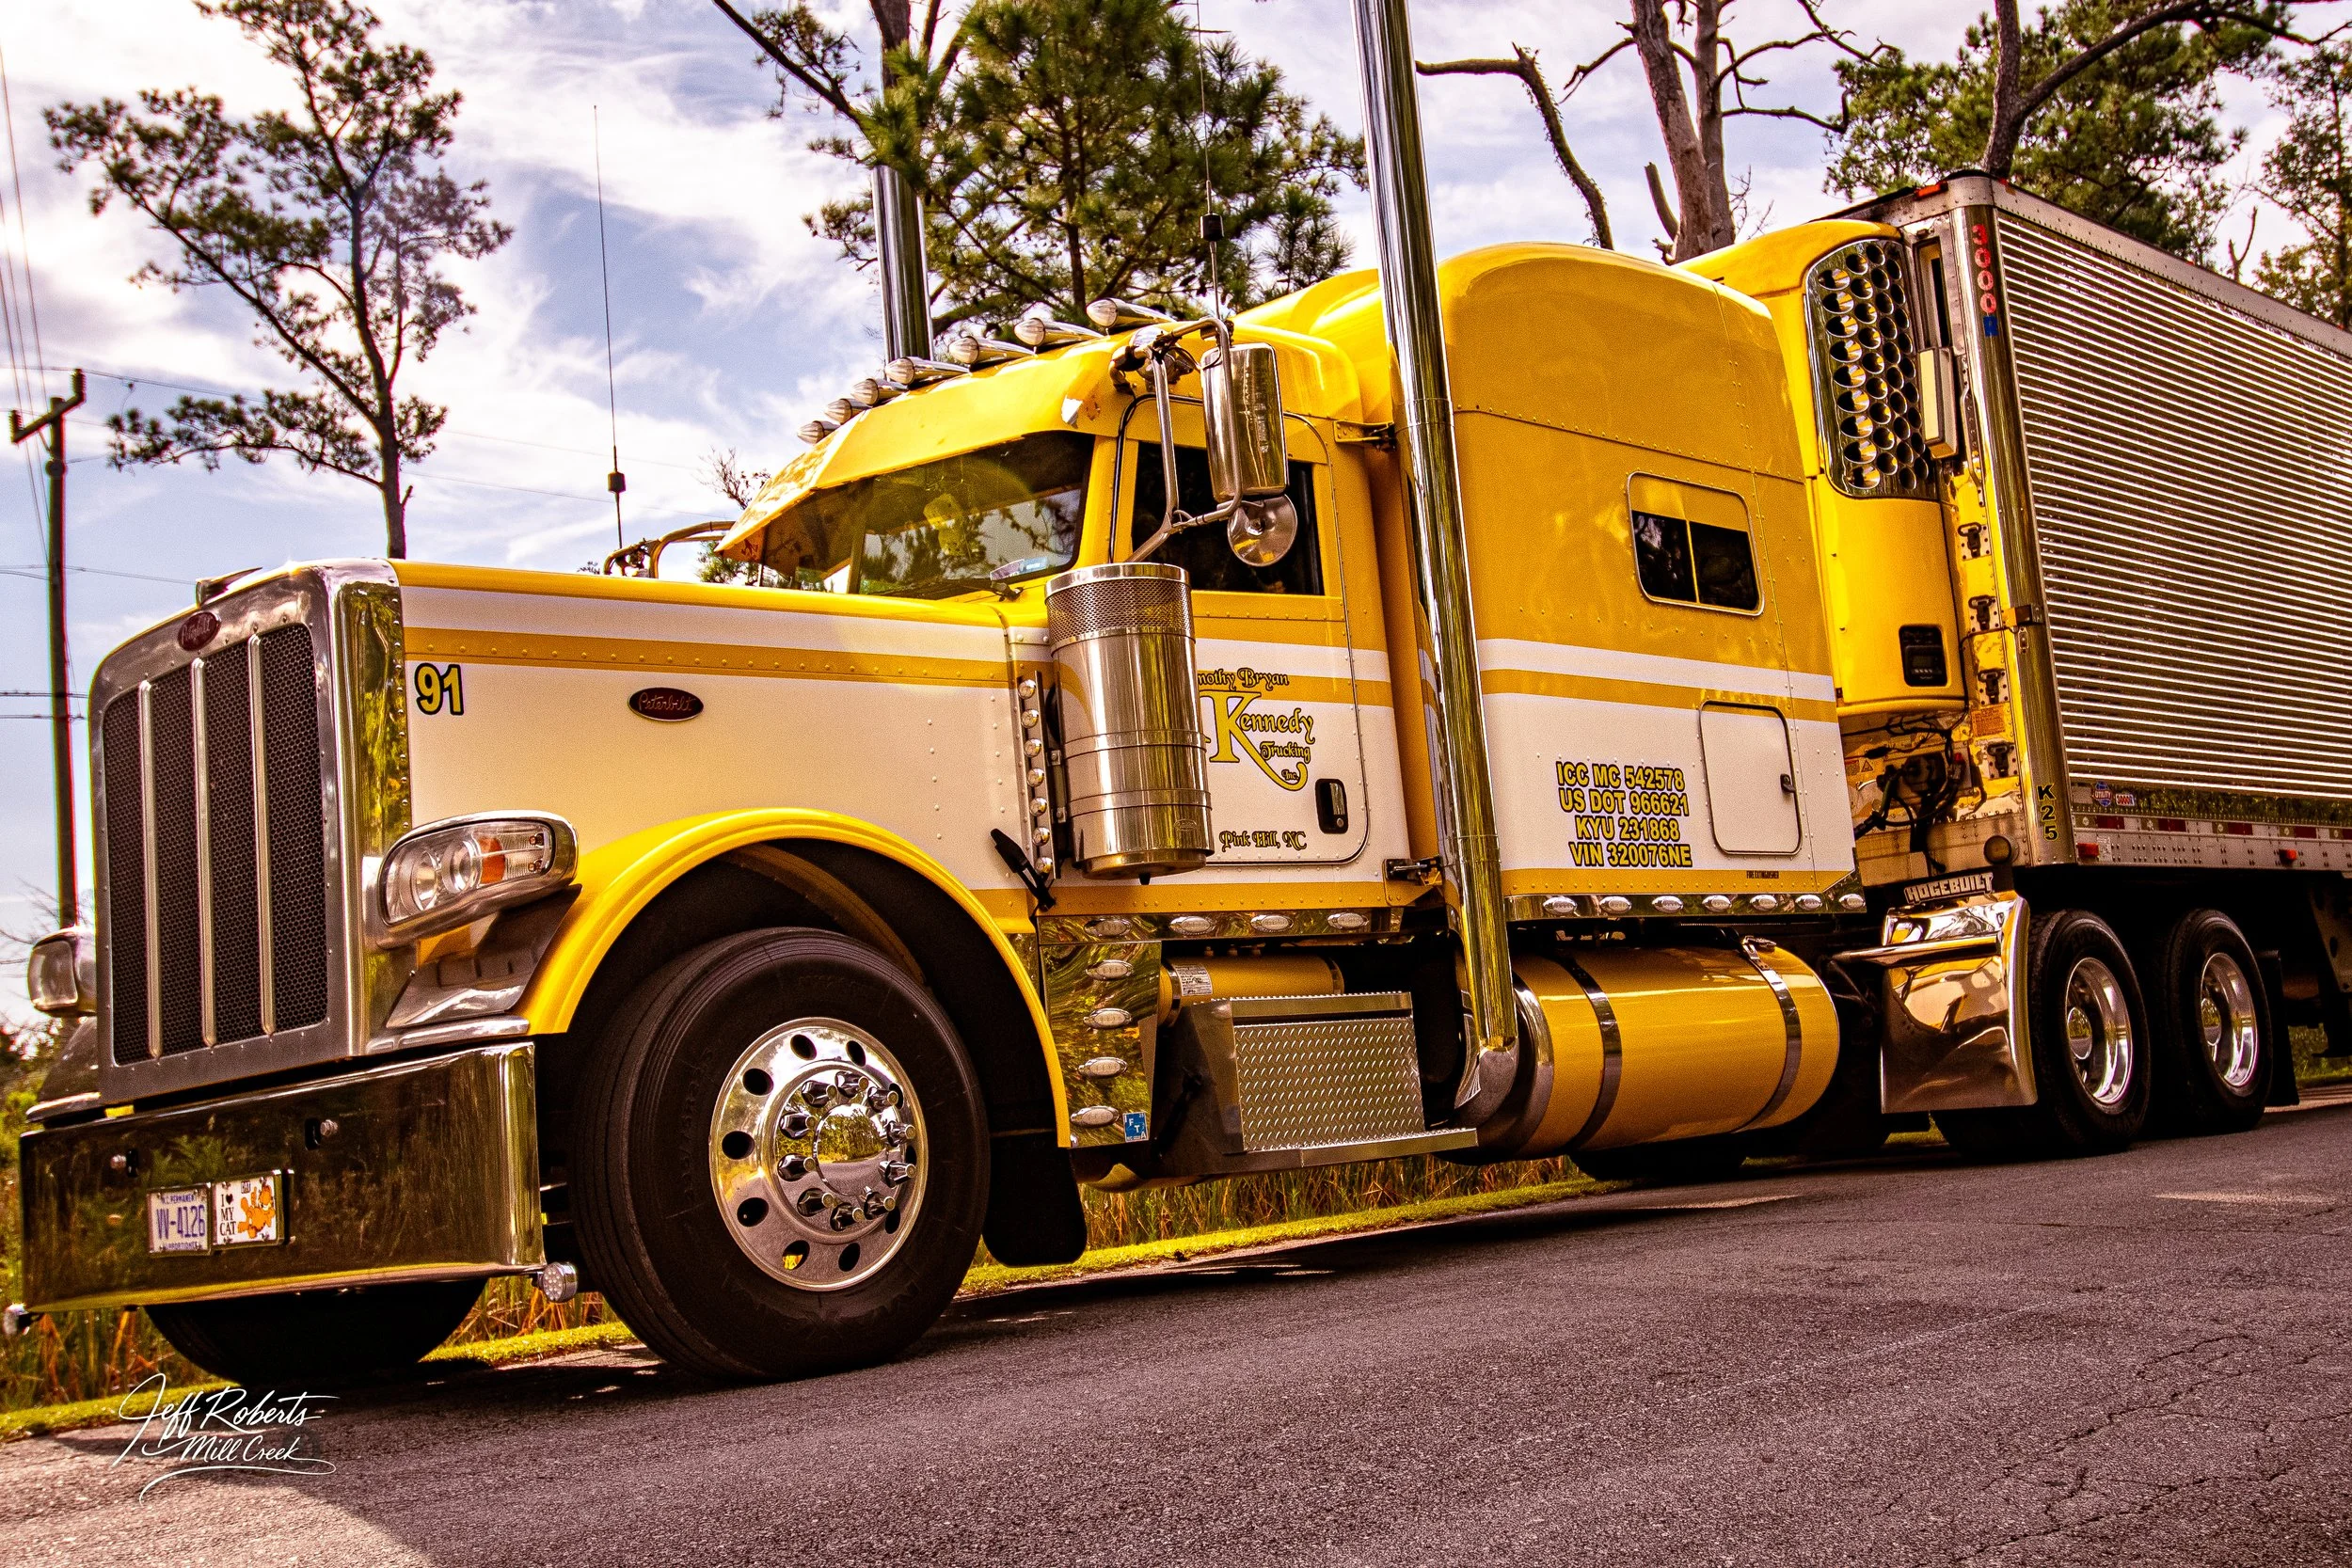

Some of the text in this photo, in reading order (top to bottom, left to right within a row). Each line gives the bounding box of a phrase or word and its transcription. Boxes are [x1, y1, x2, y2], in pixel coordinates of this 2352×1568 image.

[414, 662, 465, 717] 91
[1236, 667, 1291, 691] Bryan
[639, 691, 696, 712] Peterbilt
[1199, 689, 1316, 792] Kennedy
[1259, 740, 1311, 764] Trucking
[1280, 768, 1300, 781] Inc.
[1555, 761, 1686, 792] ICC MC 542578
[1558, 787, 1690, 816] US DOT 966621
[2094, 790, 2112, 800] UTILITY
[1574, 815, 1681, 842] KYU 231868
[1218, 830, 1308, 853] Pink Hill, NC
[1568, 841, 1693, 868] VIN 320076NE
[1904, 872, 1994, 904] HOGEBUILT
[220, 1194, 225, 1207] I
[220, 1208, 235, 1222] MY
[219, 1222, 237, 1236] CAT
